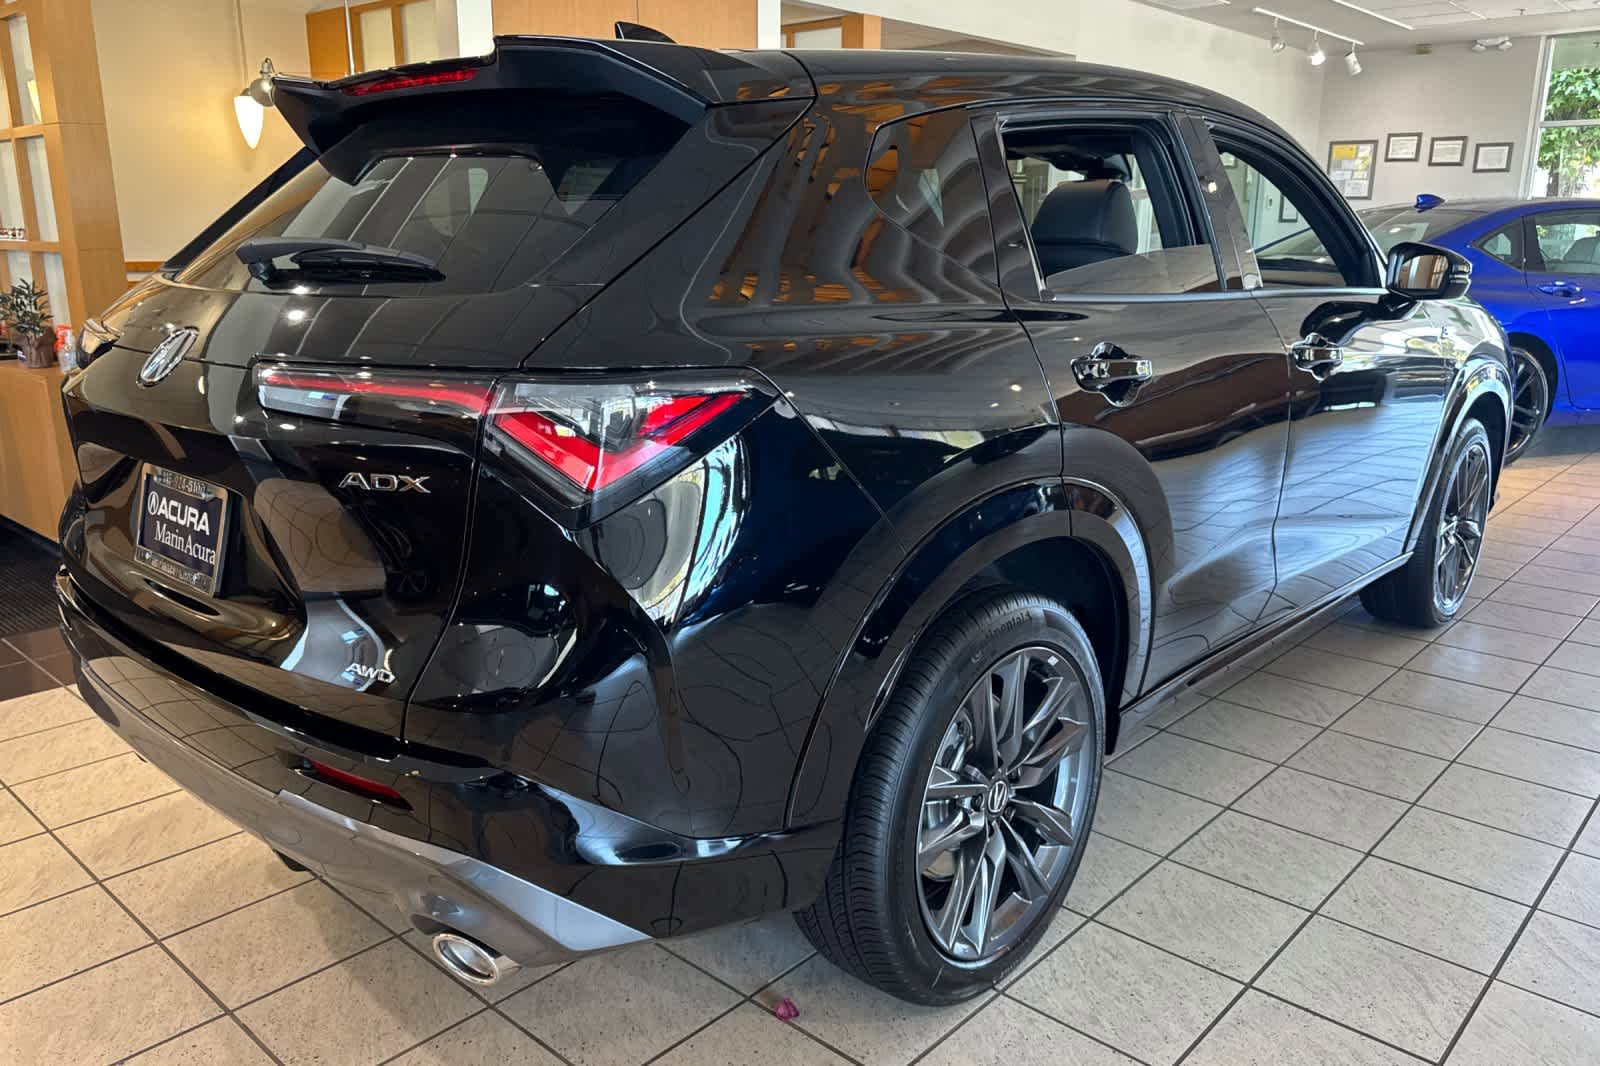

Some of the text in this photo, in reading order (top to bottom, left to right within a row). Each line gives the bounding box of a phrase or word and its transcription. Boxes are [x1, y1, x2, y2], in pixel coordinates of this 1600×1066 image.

[338, 471, 431, 493] ADX
[157, 497, 210, 536] ACURA
[345, 662, 396, 683] AWD
